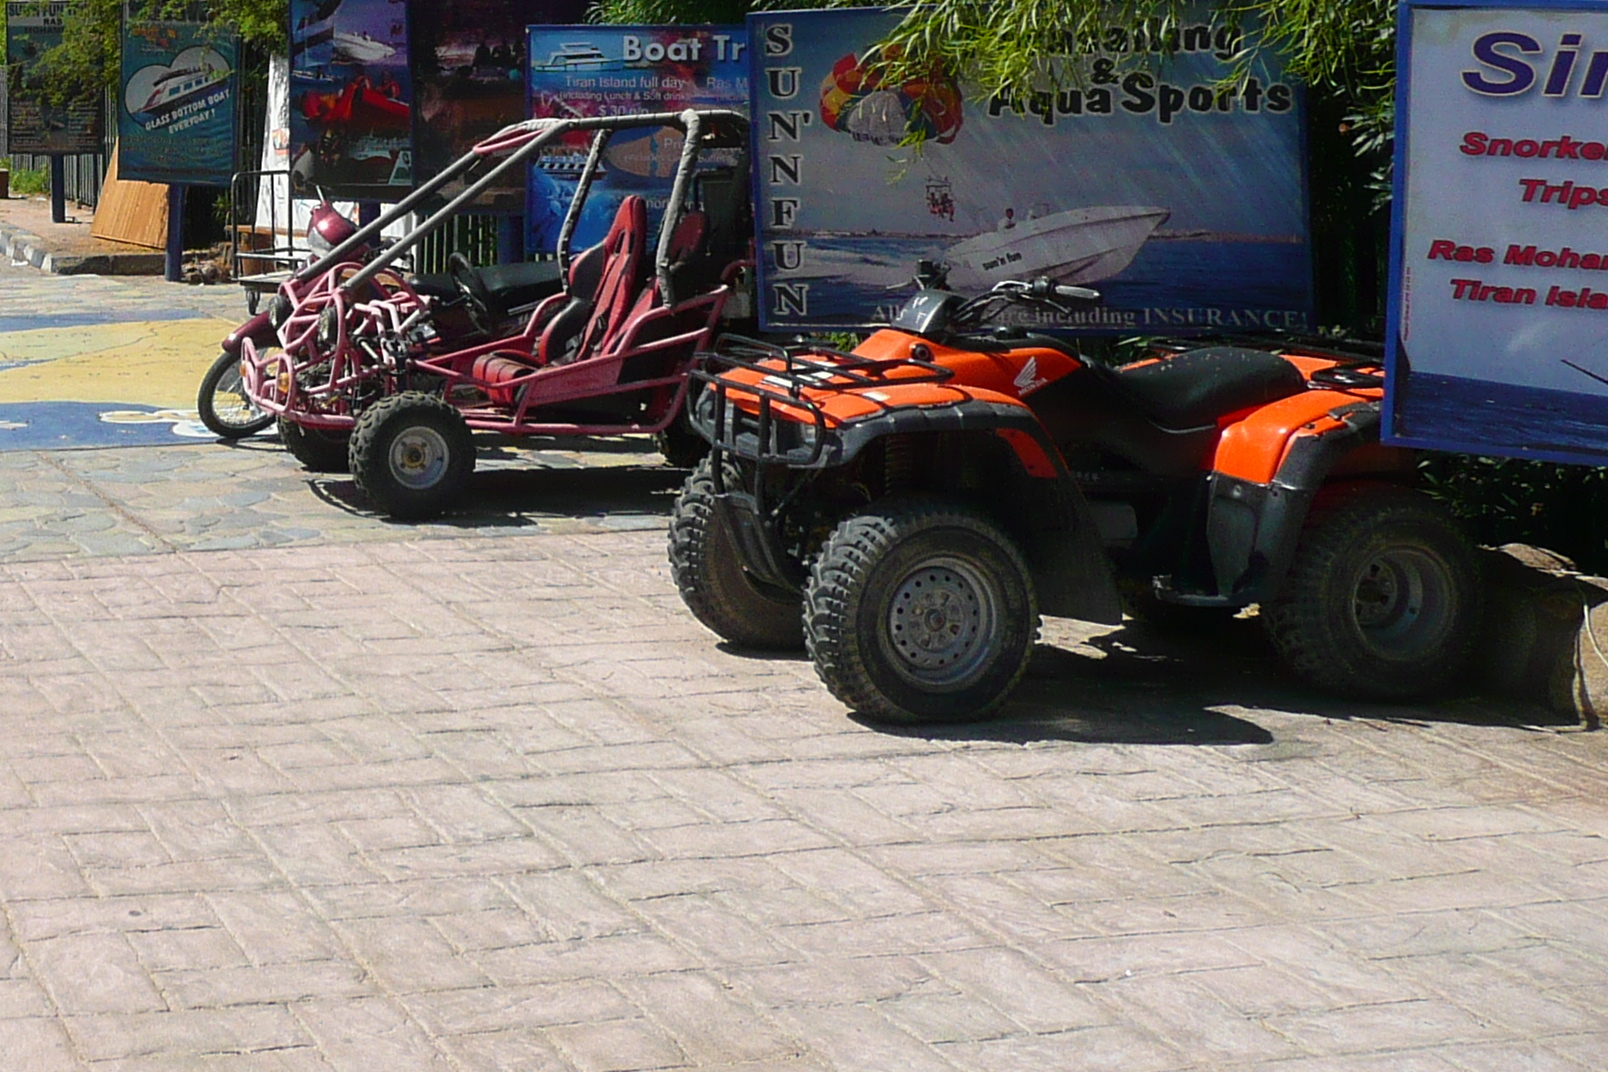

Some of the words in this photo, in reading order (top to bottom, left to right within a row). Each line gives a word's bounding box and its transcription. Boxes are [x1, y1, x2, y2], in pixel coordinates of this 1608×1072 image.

[622, 34, 703, 61] Boat
[713, 34, 746, 61] Tr
[565, 76, 596, 88] Tiran
[599, 76, 636, 88] Island
[640, 76, 658, 88] full
[661, 76, 685, 91] day
[706, 77, 731, 88] Ras
[1092, 57, 1119, 85] &
[145, 112, 171, 131] GLASS
[171, 98, 207, 123] BOTTOM
[207, 88, 231, 106] BOAT
[598, 105, 606, 116] $
[611, 105, 626, 115] 30
[1121, 73, 1292, 125] Sports
[168, 110, 209, 134] EVERYDAY
[1459, 132, 1608, 160] Snorke
[1006, 252, 1023, 264] fun
[1427, 239, 1495, 264] Ras
[1503, 243, 1608, 271] Moha
[1450, 278, 1537, 305] Tiran
[1035, 305, 1136, 328] including
[1143, 304, 1309, 329] INSURANCE!
